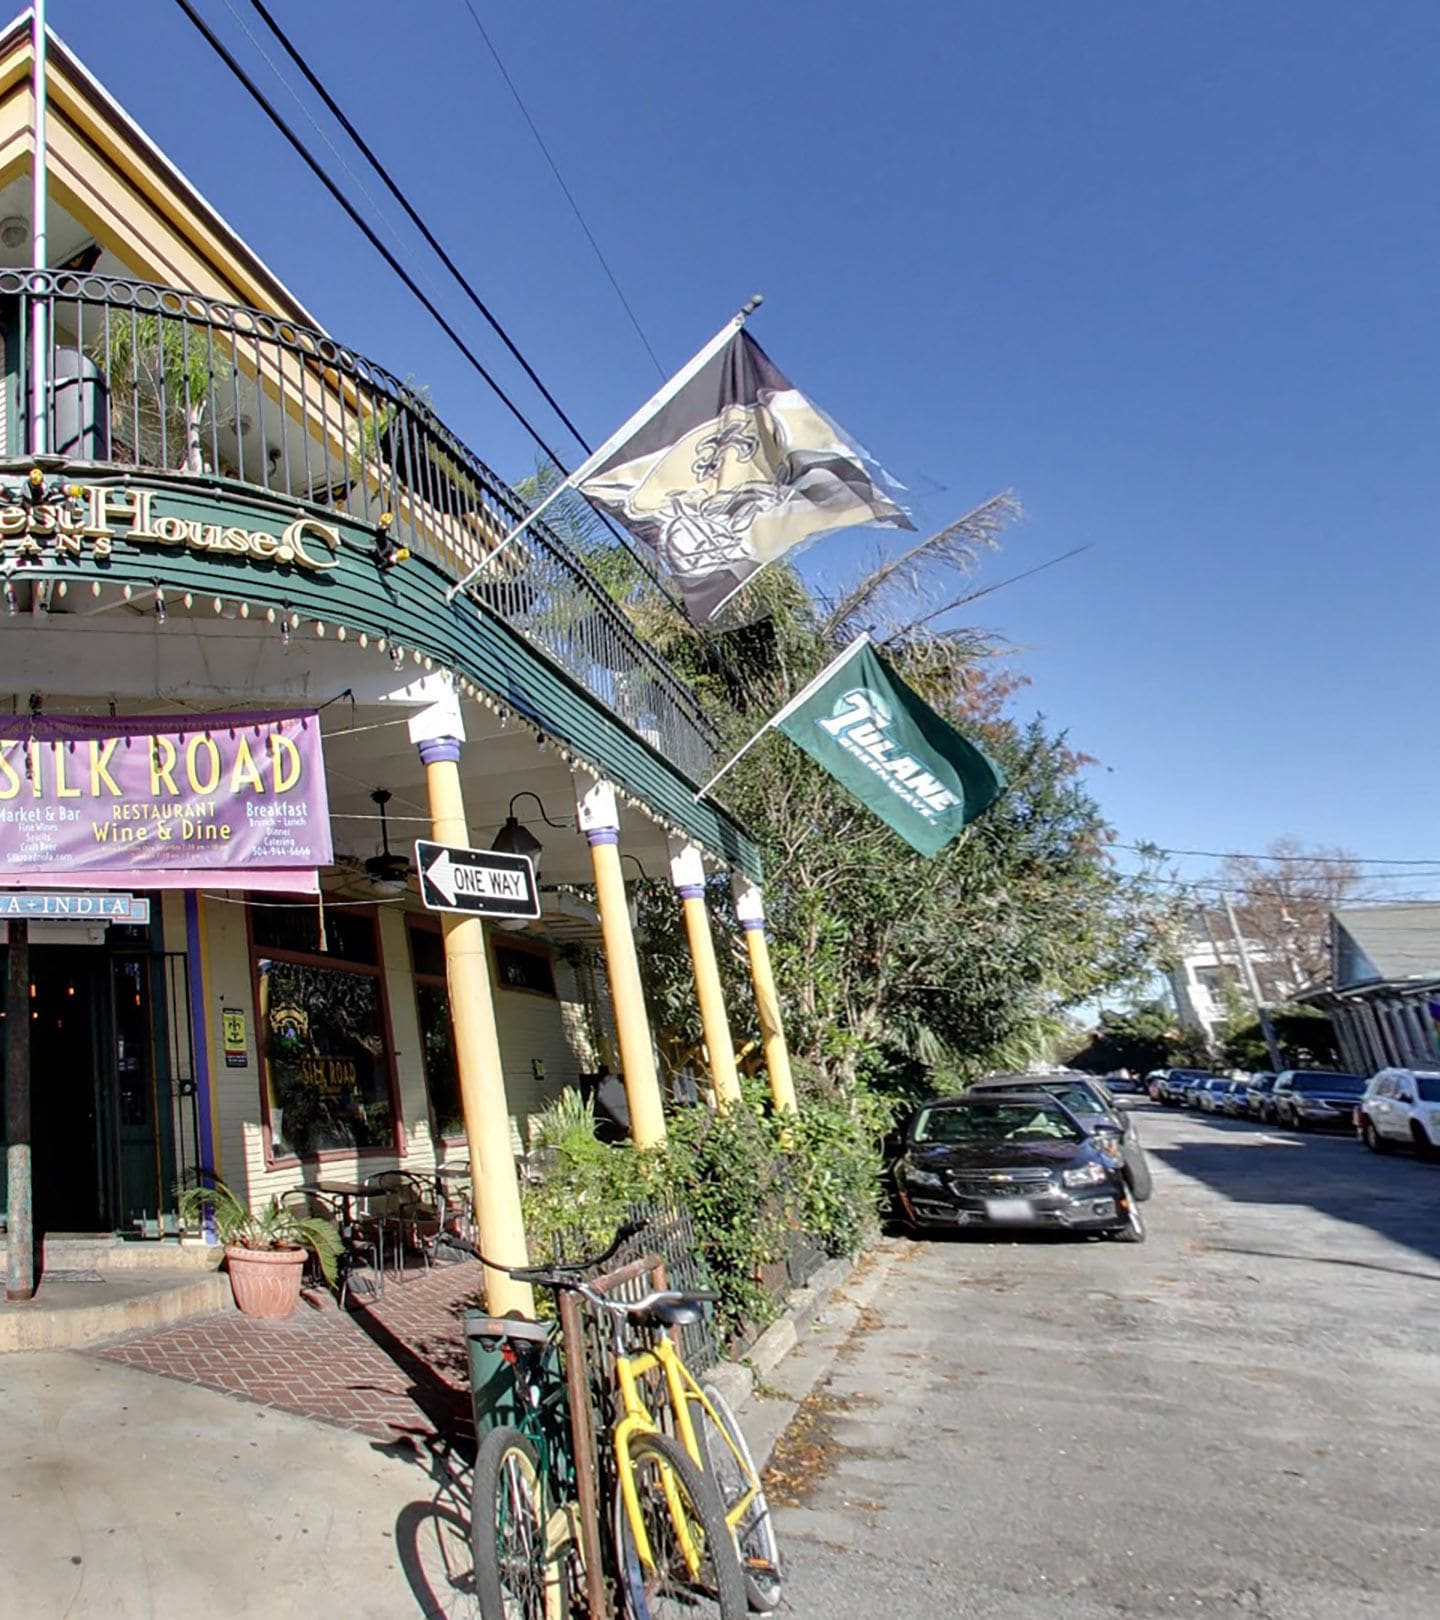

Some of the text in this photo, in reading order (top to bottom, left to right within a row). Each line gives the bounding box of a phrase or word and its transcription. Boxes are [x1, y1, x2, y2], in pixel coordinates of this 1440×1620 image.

[817, 690, 963, 812] TULANE
[149, 733, 301, 797] ROAD
[45, 806, 55, 821] &
[59, 805, 80, 821] Bar
[112, 801, 216, 820] RESTAURANT
[246, 800, 308, 817] Breakfast
[92, 818, 232, 842] Wine & Dine
[453, 866, 523, 898] ONE WAY
[42, 896, 127, 915] INDIA
